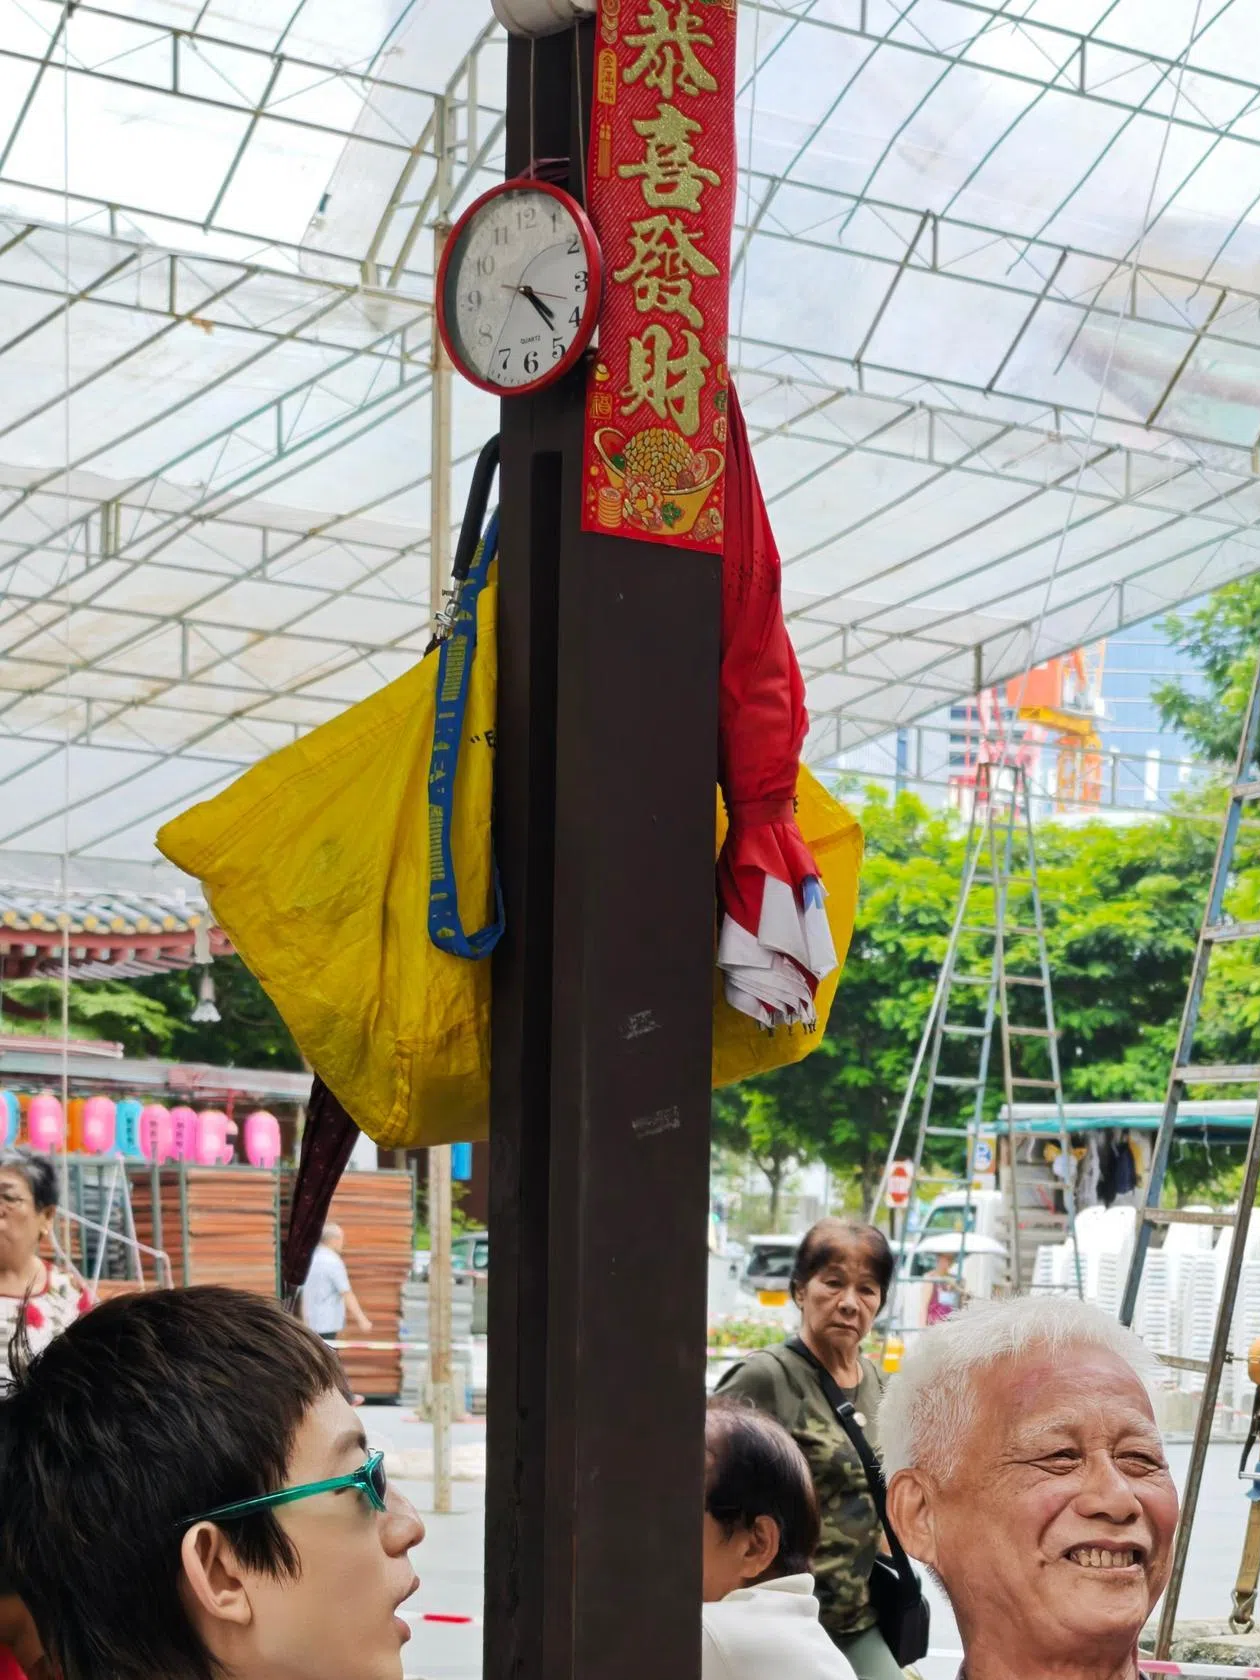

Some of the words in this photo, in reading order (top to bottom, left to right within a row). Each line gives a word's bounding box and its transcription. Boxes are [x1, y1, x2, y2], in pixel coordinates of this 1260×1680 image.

[516, 207, 537, 230] 12
[550, 212, 557, 233] 1
[614, 0, 721, 436] 恭喜發財
[494, 225, 509, 245] 11
[566, 234, 581, 255] 2
[476, 255, 495, 277] 10
[574, 270, 588, 293] 3
[467, 290, 482, 312] 9
[568, 306, 583, 328] 4
[478, 324, 493, 346] 8
[520, 335, 541, 345] QUARTZ
[498, 347, 512, 370] 7
[552, 336, 566, 359] 5
[523, 351, 539, 374] 6
